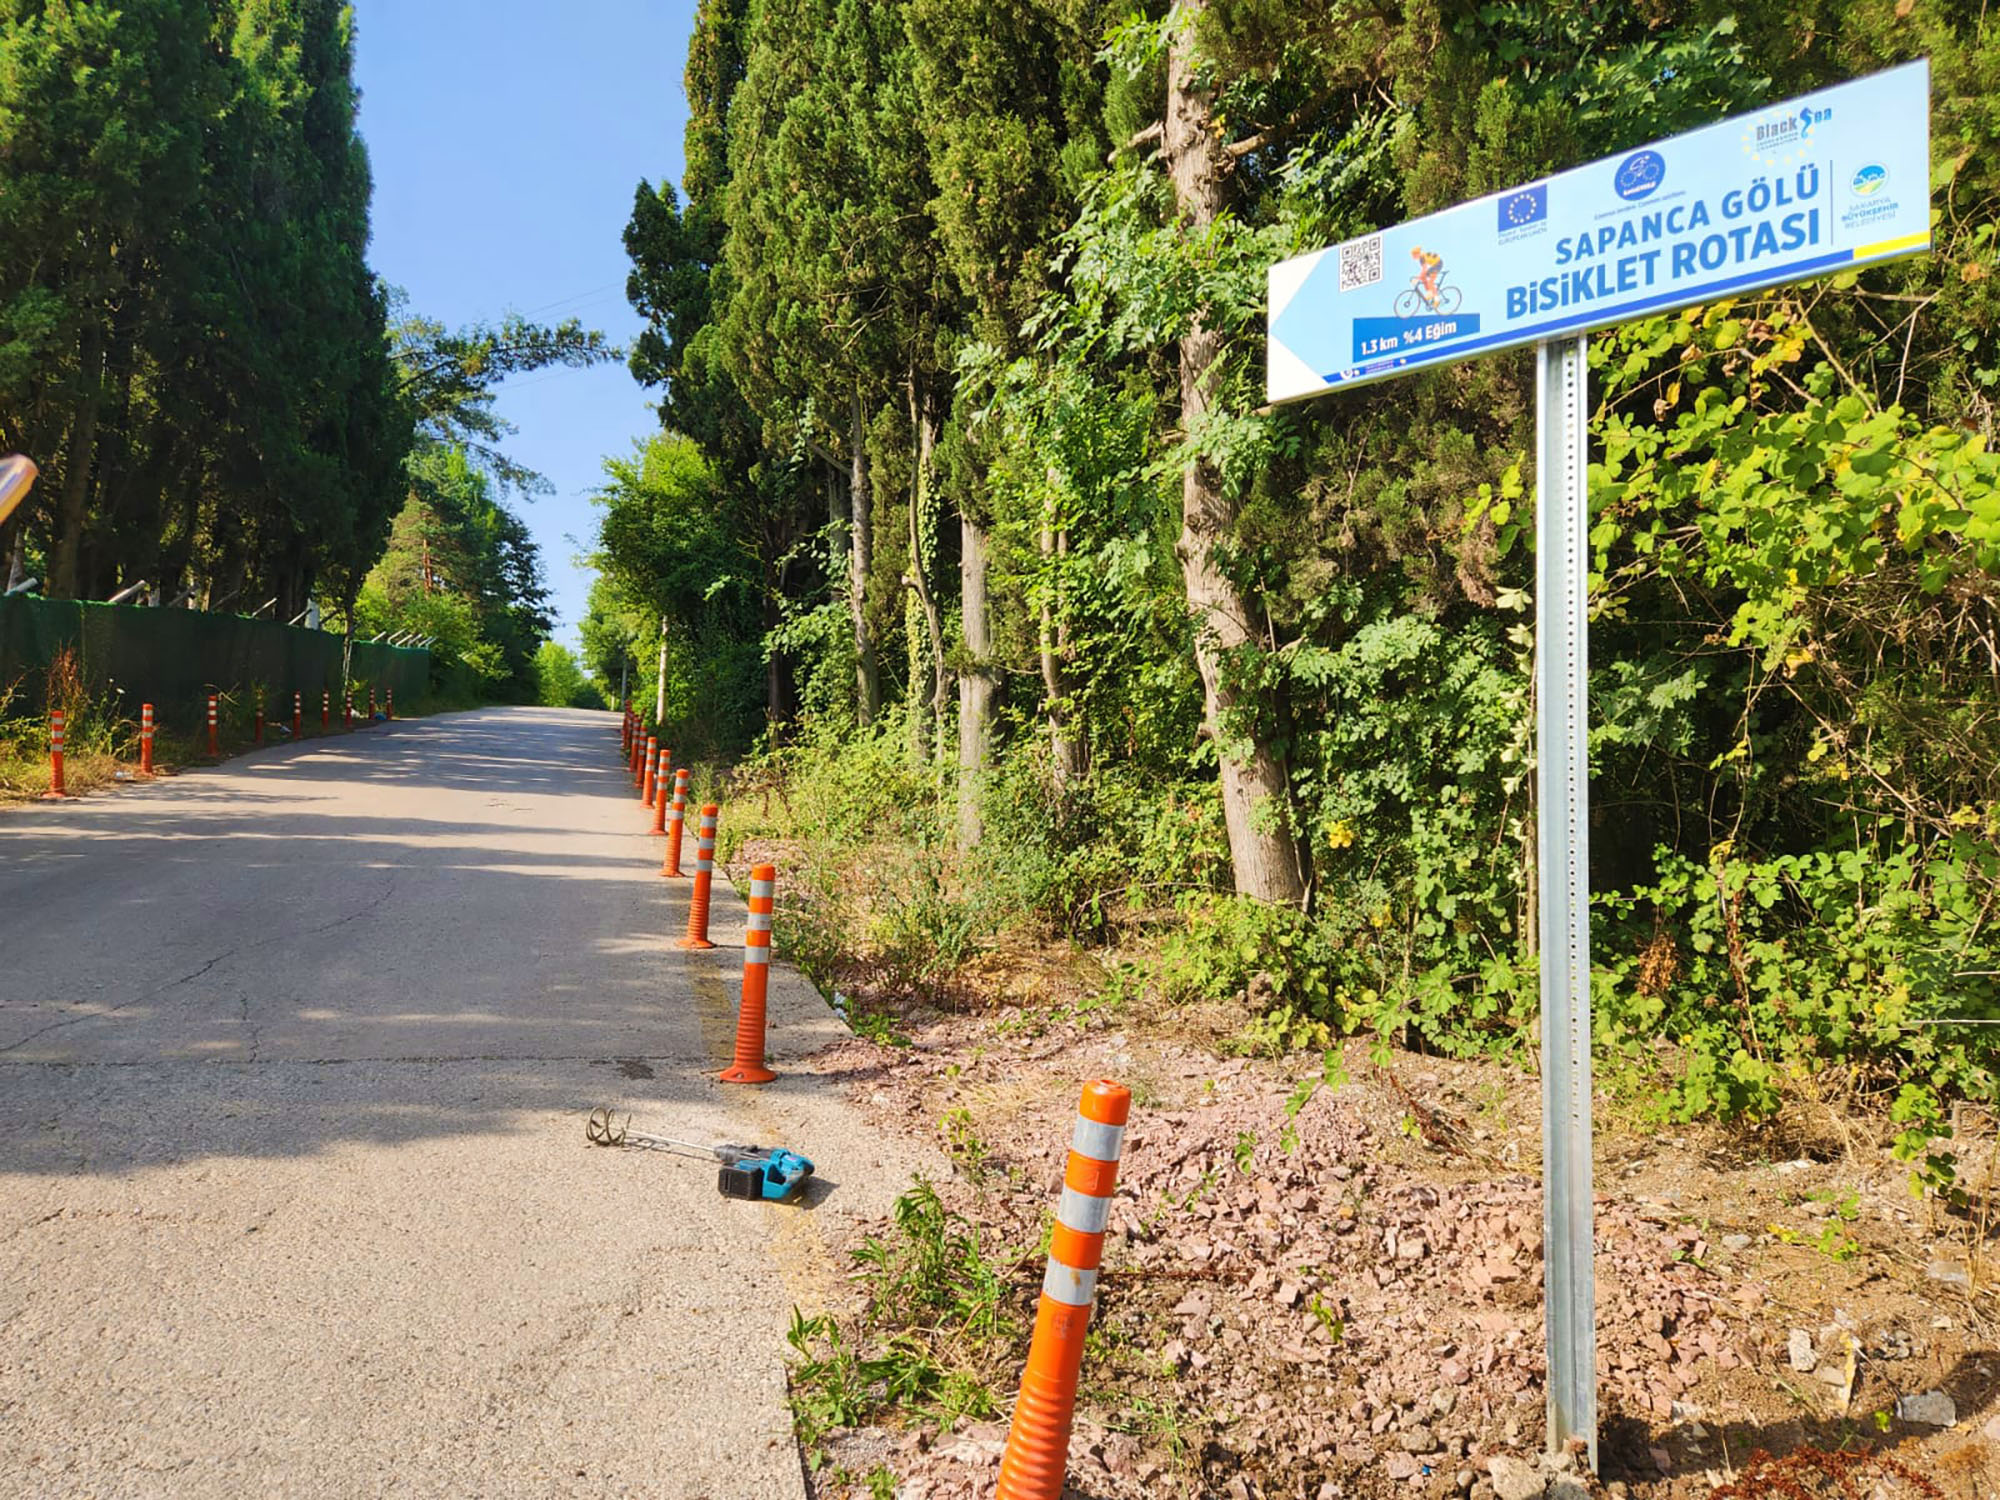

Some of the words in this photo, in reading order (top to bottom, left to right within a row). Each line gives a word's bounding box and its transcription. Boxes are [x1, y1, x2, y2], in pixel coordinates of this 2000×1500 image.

[1756, 117, 1797, 141] Black
[1555, 200, 1710, 264] SAPANCA
[1721, 163, 1818, 220] GÖLÜ
[1672, 208, 1818, 279] ROTASI
[1361, 338, 1378, 355] 1.3
[1379, 336, 1398, 351] km
[1402, 327, 1423, 344] %4
[1425, 321, 1458, 340] Eğim
